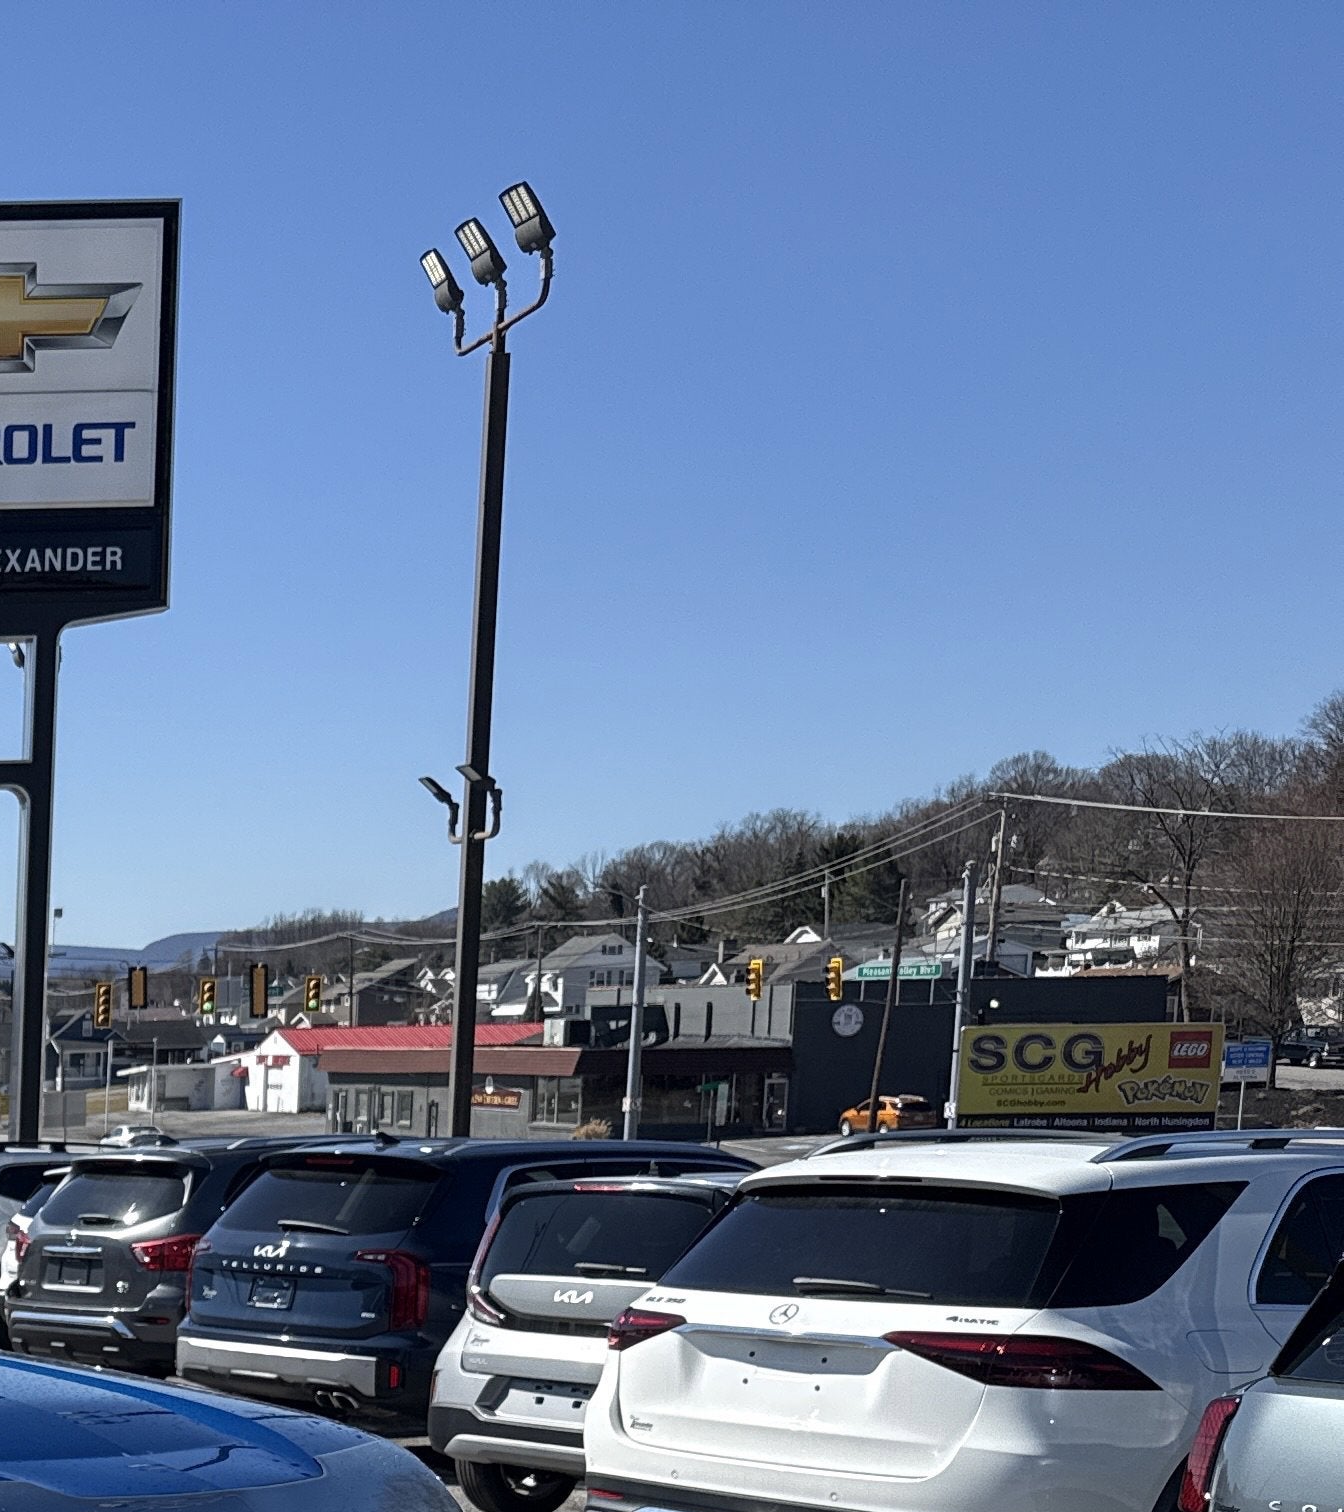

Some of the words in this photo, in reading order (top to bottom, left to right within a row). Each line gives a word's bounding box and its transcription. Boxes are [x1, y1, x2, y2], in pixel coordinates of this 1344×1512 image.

[968, 1032, 1105, 1074] SCG
[1172, 1041, 1210, 1057] LEGO
[1076, 1034, 1153, 1094] Hobby
[989, 1087, 1029, 1096] COMICS
[1034, 1087, 1076, 1096] GAMING
[1013, 1118, 1048, 1126] Latrobe
[1053, 1118, 1088, 1126] Altoona
[1094, 1117, 1127, 1126] Indiana
[1135, 1117, 1160, 1126] North
[221, 1259, 324, 1275] TELLURIDE
